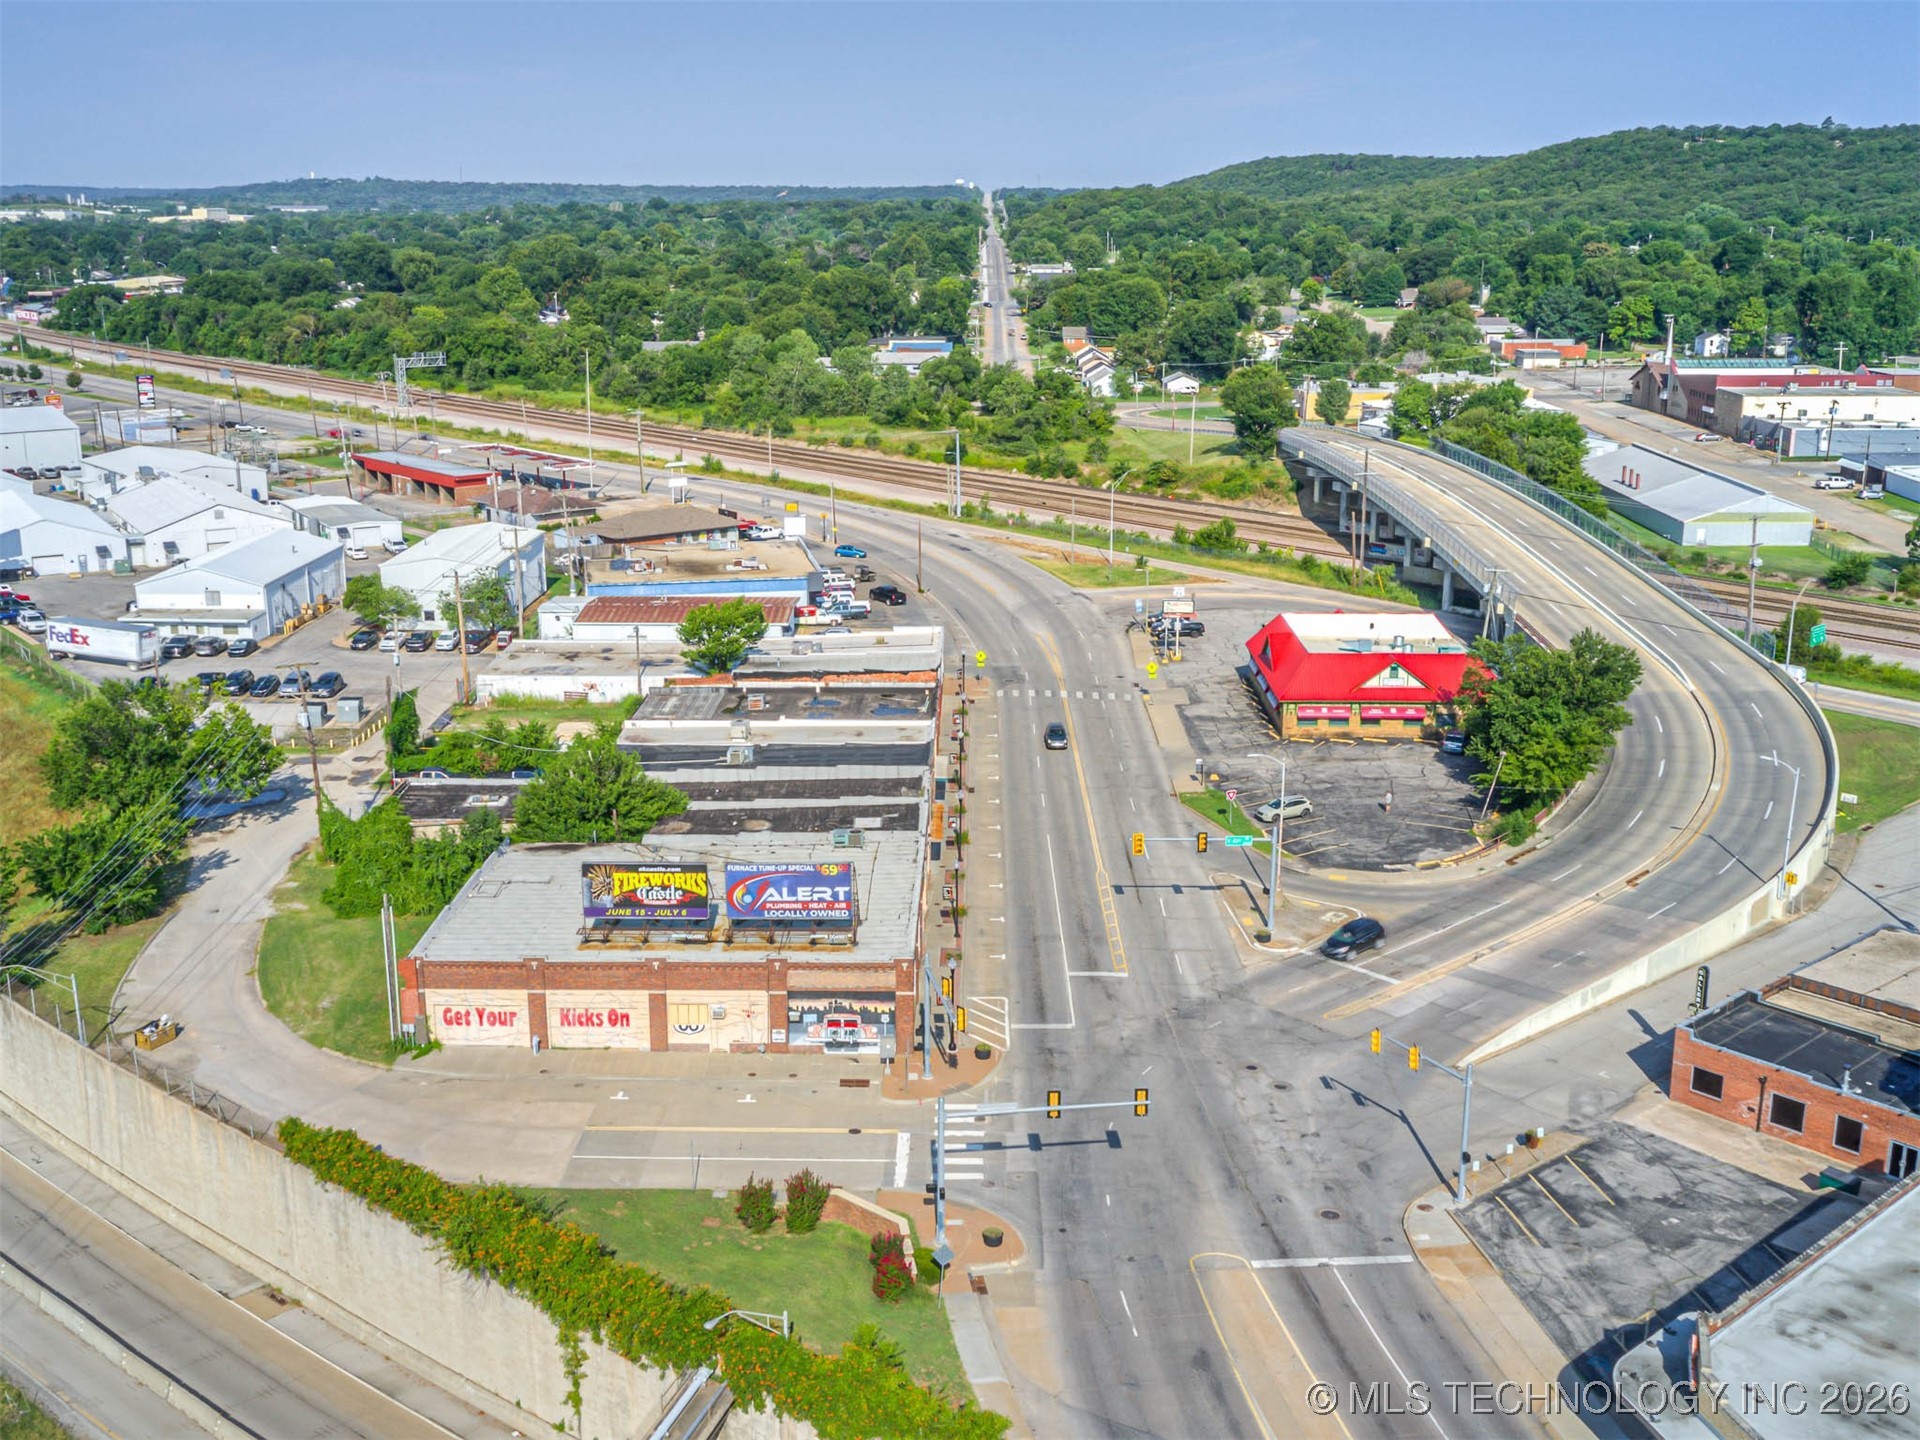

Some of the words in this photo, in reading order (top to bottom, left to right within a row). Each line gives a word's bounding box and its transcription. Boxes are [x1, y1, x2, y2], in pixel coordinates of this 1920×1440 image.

[49, 625, 90, 646] FedEx
[613, 872, 708, 897] FIREWORKS
[636, 885, 684, 900] Castle
[760, 887, 850, 902] ALERT
[1695, 970, 1704, 1008] GALLERY
[443, 1007, 471, 1027] Get
[475, 1007, 517, 1027] Your
[560, 1008, 604, 1027] Kicks
[607, 1008, 630, 1027] On
